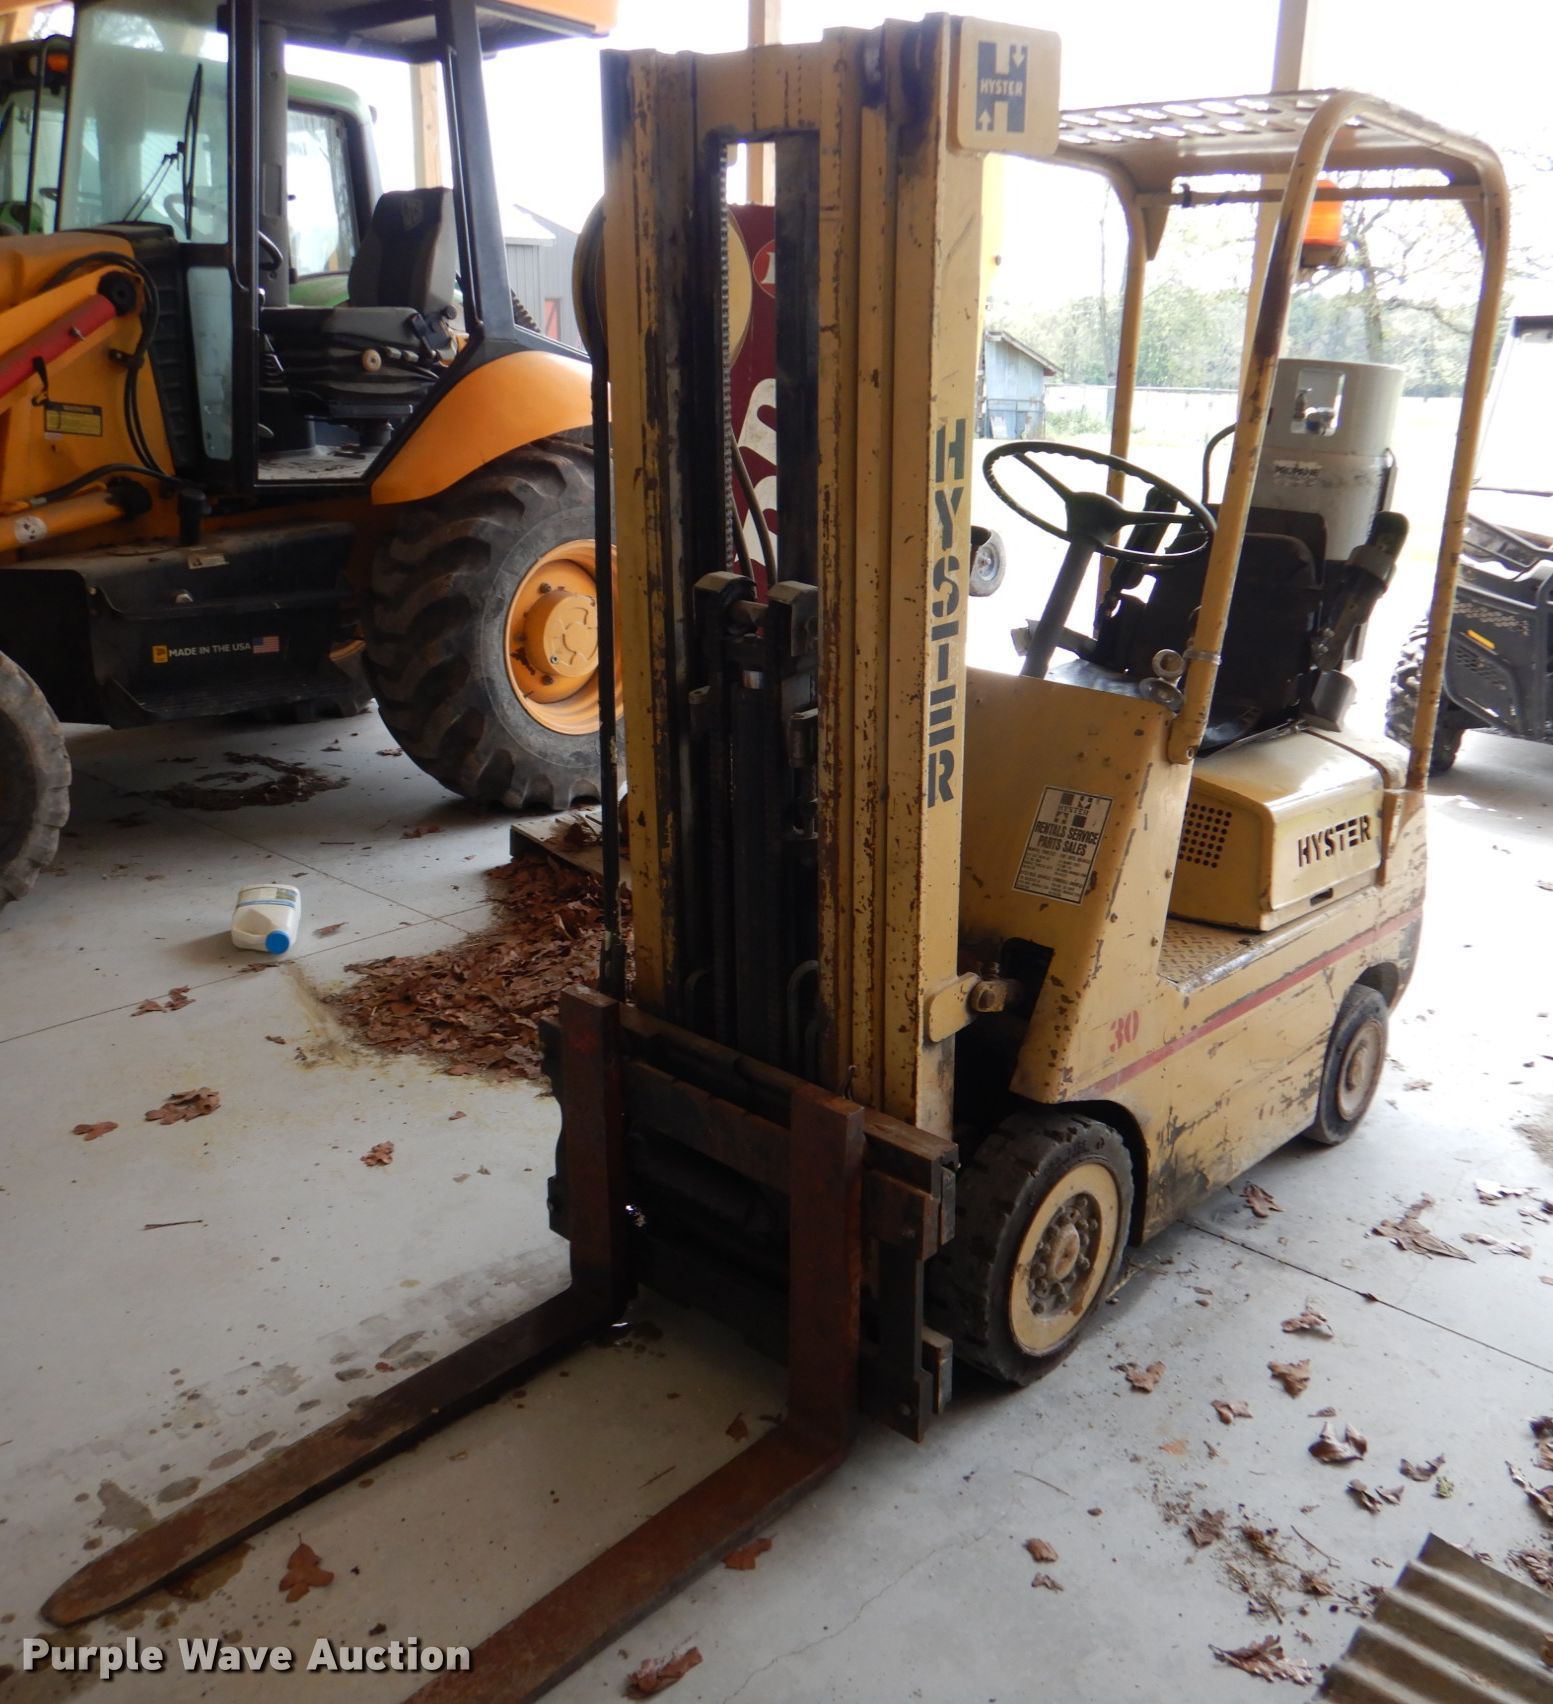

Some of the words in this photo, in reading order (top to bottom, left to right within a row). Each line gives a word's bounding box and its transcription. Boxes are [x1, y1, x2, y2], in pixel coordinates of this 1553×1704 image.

[980, 79, 1024, 96] HYSTER
[927, 417, 966, 809] HYSTER
[169, 647, 197, 657] MADE
[199, 645, 210, 655] IN
[212, 644, 231, 653] THE
[232, 642, 251, 651] USA
[1034, 821, 1067, 838] RENTALS
[1067, 828, 1099, 845] SERVICE
[1298, 815, 1371, 867] HYSTER
[1037, 835, 1062, 851] PARTS
[1062, 841, 1087, 856] SALES
[1109, 1010, 1139, 1053] 30
